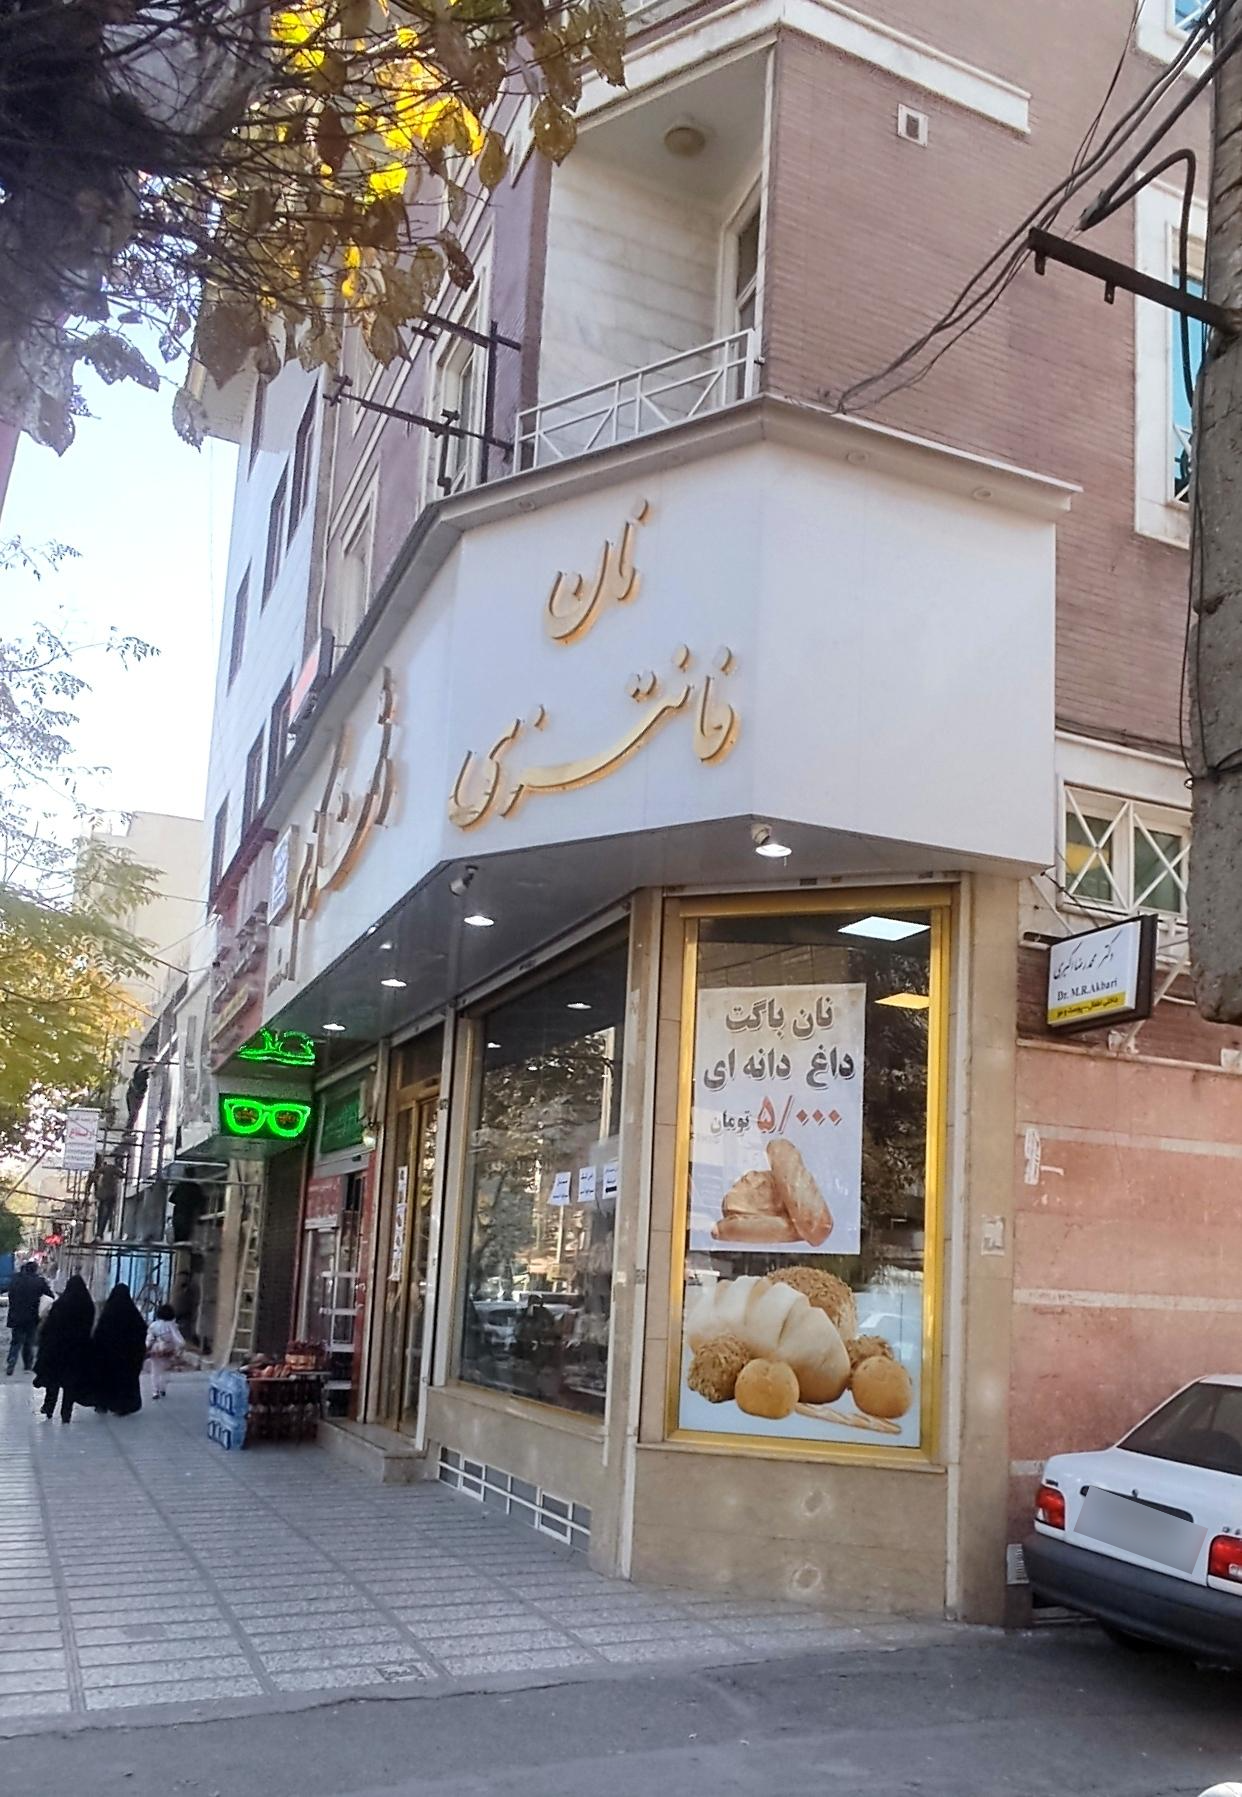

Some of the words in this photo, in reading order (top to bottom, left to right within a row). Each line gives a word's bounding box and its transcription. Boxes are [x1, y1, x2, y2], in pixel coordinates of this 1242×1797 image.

[546, 499, 649, 641] نان
[448, 645, 736, 832] فانتزی
[1053, 942, 1082, 980] اکبری
[1098, 929, 1122, 968] دکتر
[1057, 990, 1069, 1001] Dr.
[725, 998, 784, 1039] باگت
[792, 996, 833, 1039] نان
[703, 1048, 736, 1091] ای
[742, 1047, 791, 1081] دانه
[806, 1044, 856, 1090] داغ
[710, 1110, 750, 1135] تومان
[757, 1095, 842, 1134] ۵/۰۰۰
